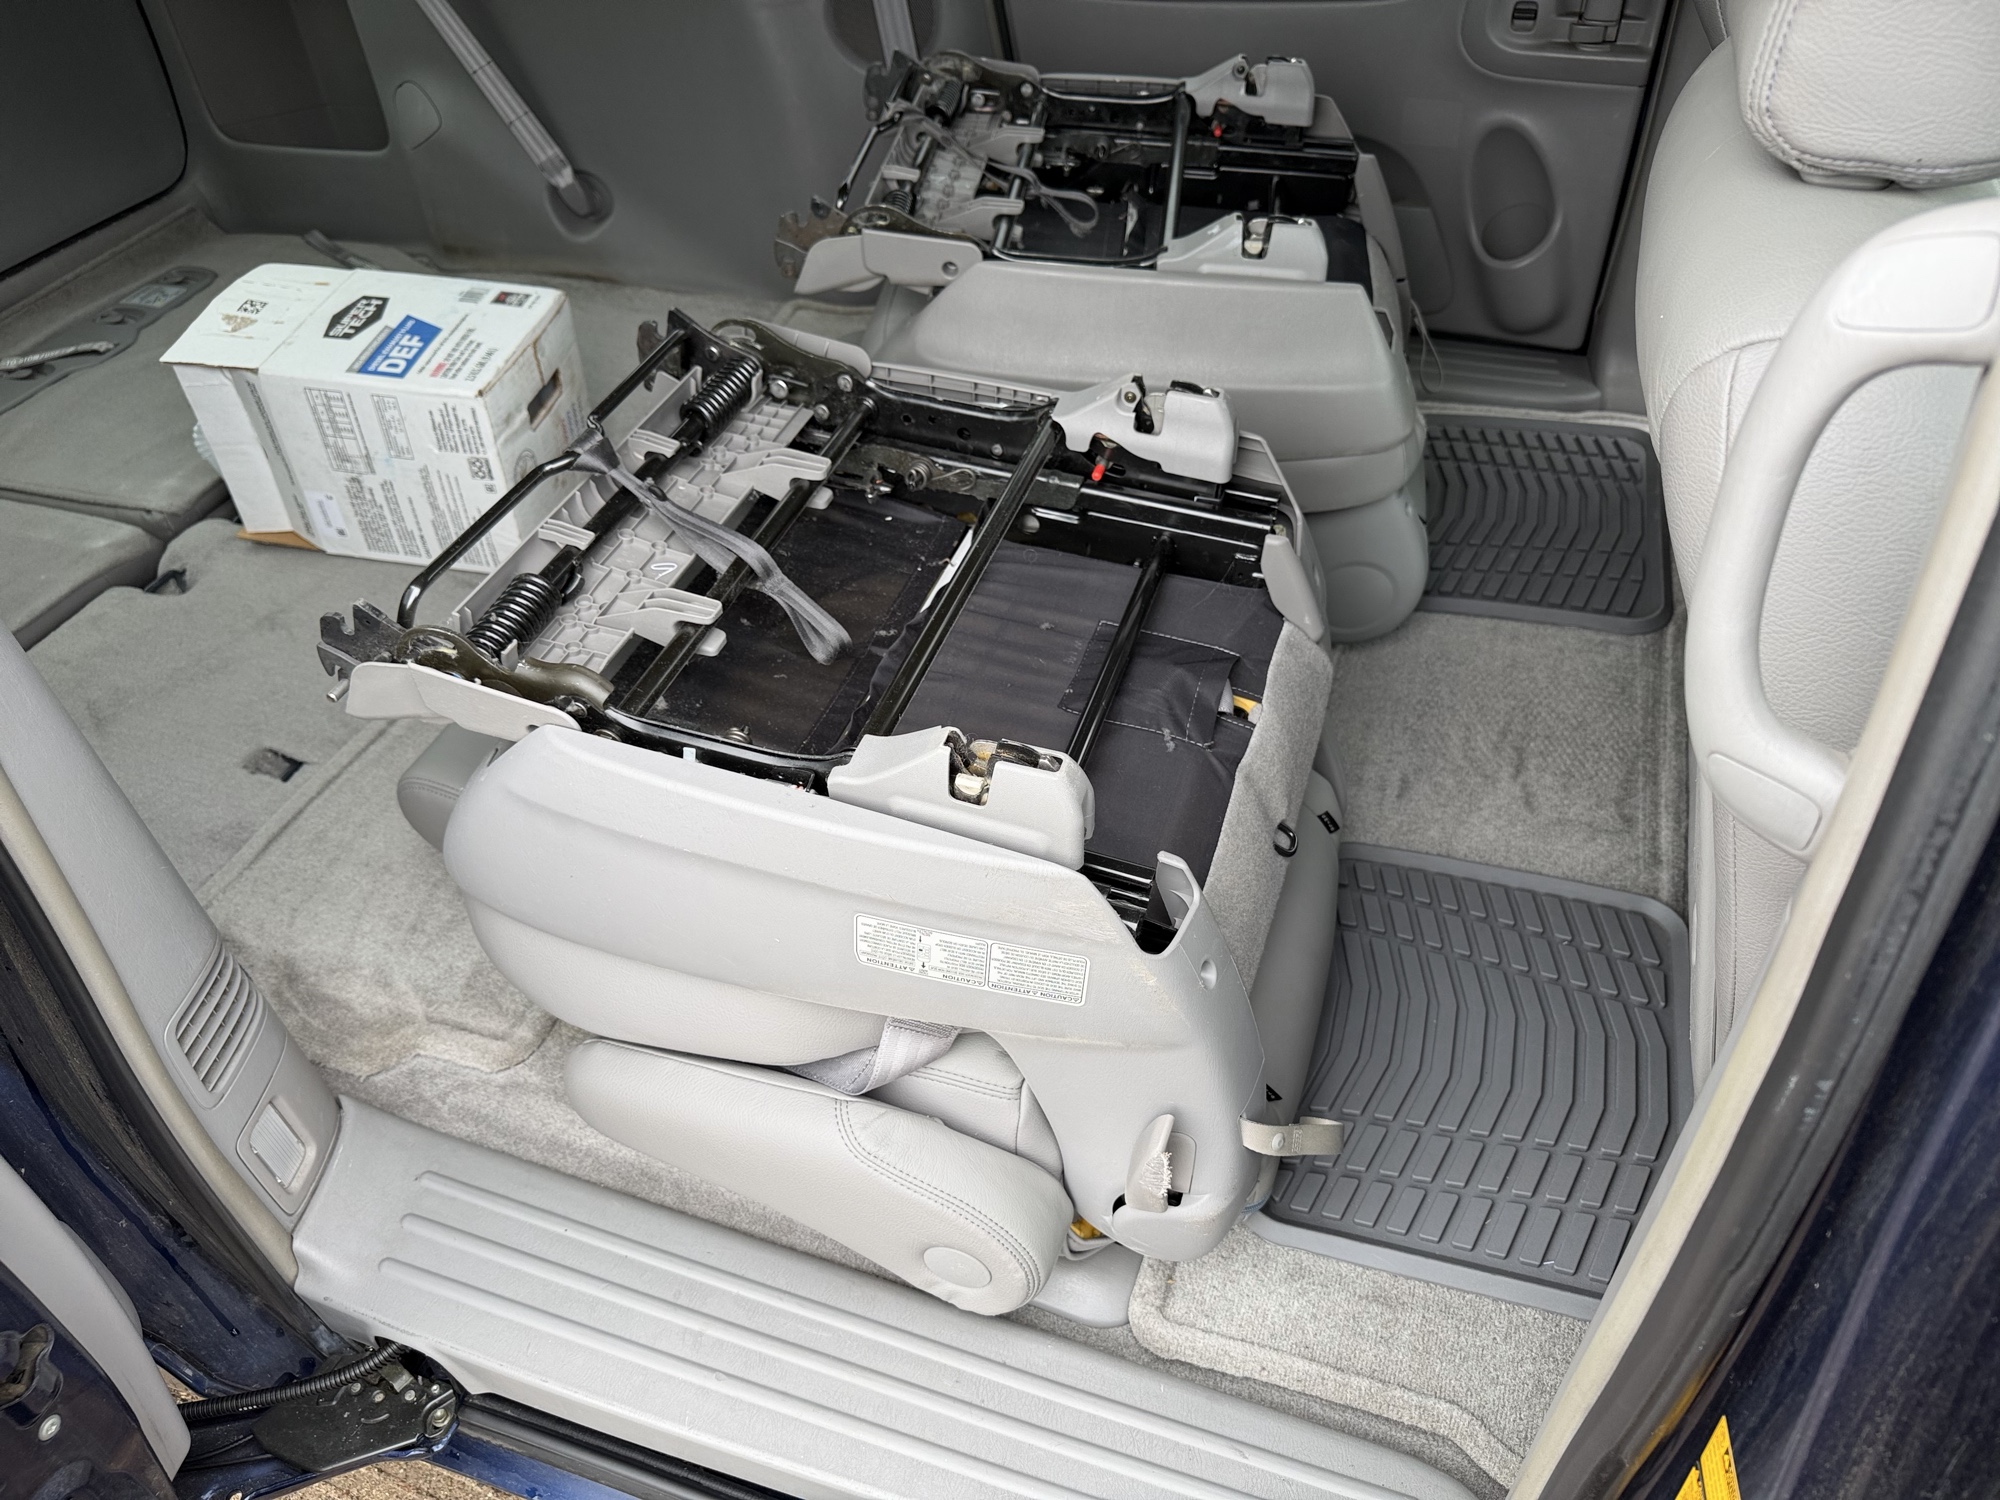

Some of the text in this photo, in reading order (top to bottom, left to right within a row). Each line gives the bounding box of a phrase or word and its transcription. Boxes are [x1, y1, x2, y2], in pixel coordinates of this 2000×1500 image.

[329, 299, 369, 337] SUPER
[340, 299, 383, 337] TECH
[377, 334, 424, 374] DEF
[866, 957, 908, 971] ATTENTION
[942, 974, 977, 985] CAUTION
[991, 983, 1073, 1002] CAUTION ATTENTION
